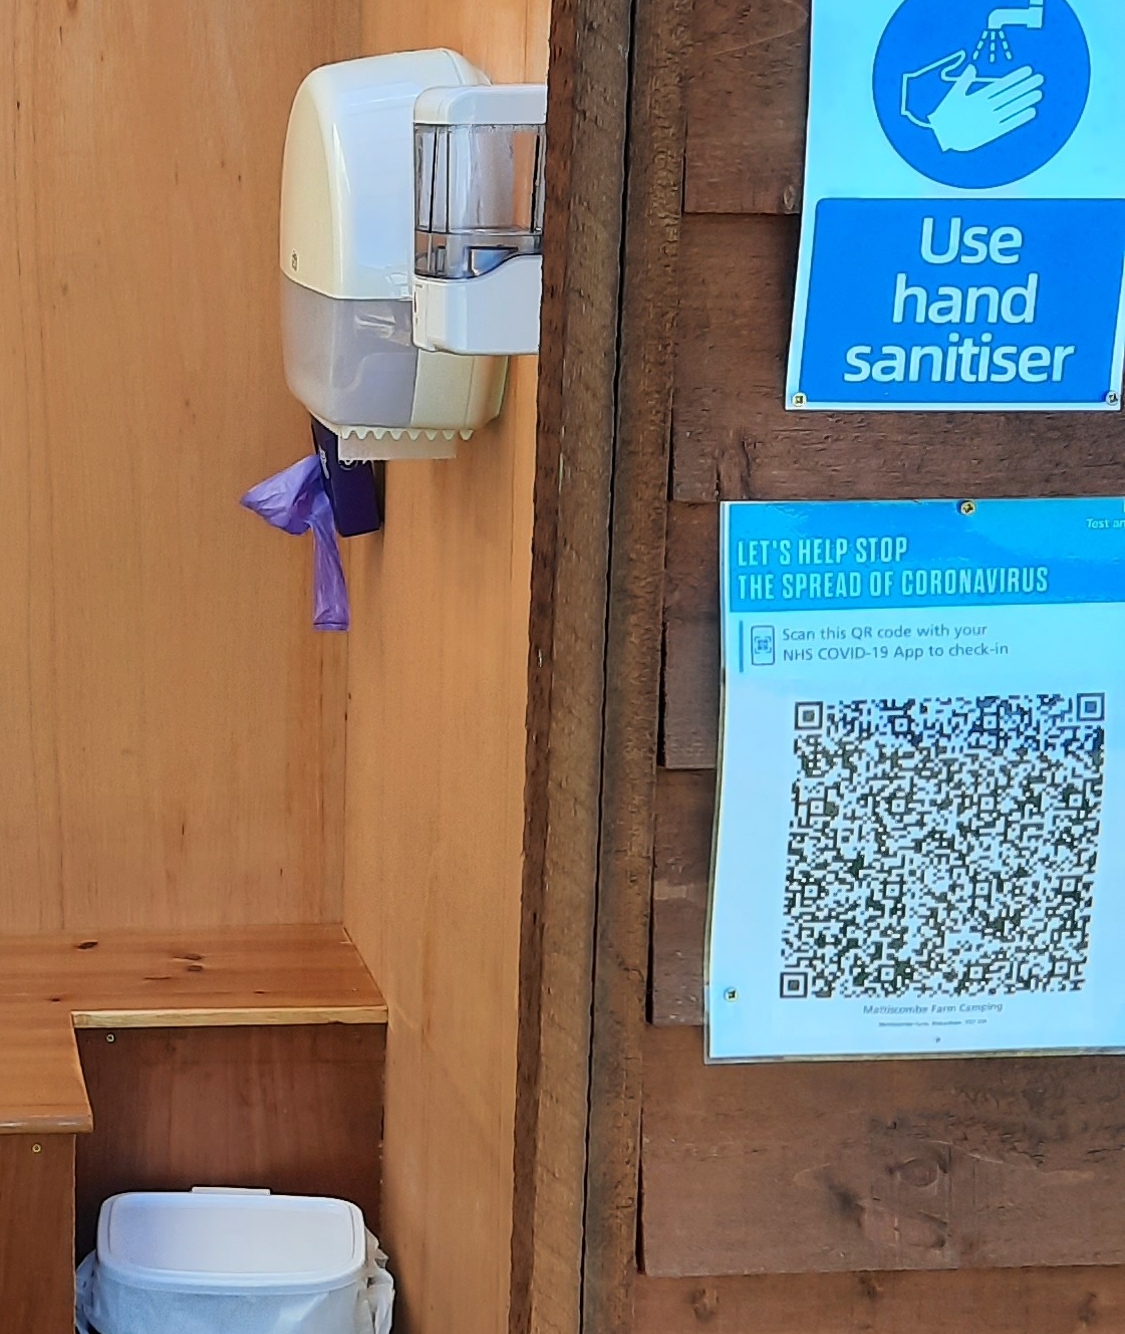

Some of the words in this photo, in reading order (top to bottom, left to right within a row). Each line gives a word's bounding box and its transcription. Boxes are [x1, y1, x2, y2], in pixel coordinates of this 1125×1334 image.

[920, 217, 1023, 265] Use
[892, 272, 1039, 324] hand
[843, 332, 1076, 383] sanitiser
[738, 540, 791, 566] LET'S
[798, 538, 848, 565] HELP
[855, 537, 907, 563] STOP
[738, 574, 775, 600] THE
[782, 572, 861, 599] SPREAD
[869, 571, 894, 596] OF
[901, 567, 1048, 596] CORONAVIRUS
[782, 628, 815, 641] Scan
[821, 626, 846, 640] this
[851, 626, 873, 640] QR
[877, 625, 911, 639] code
[917, 623, 949, 637] with
[954, 625, 988, 639] your
[783, 648, 813, 661] NHS
[818, 645, 888, 661] COVID-19
[893, 645, 924, 661] App
[929, 645, 944, 657] to
[948, 641, 1009, 657] check-in
[931, 1003, 956, 1013] Farm
[959, 1001, 1003, 1013] Camping
